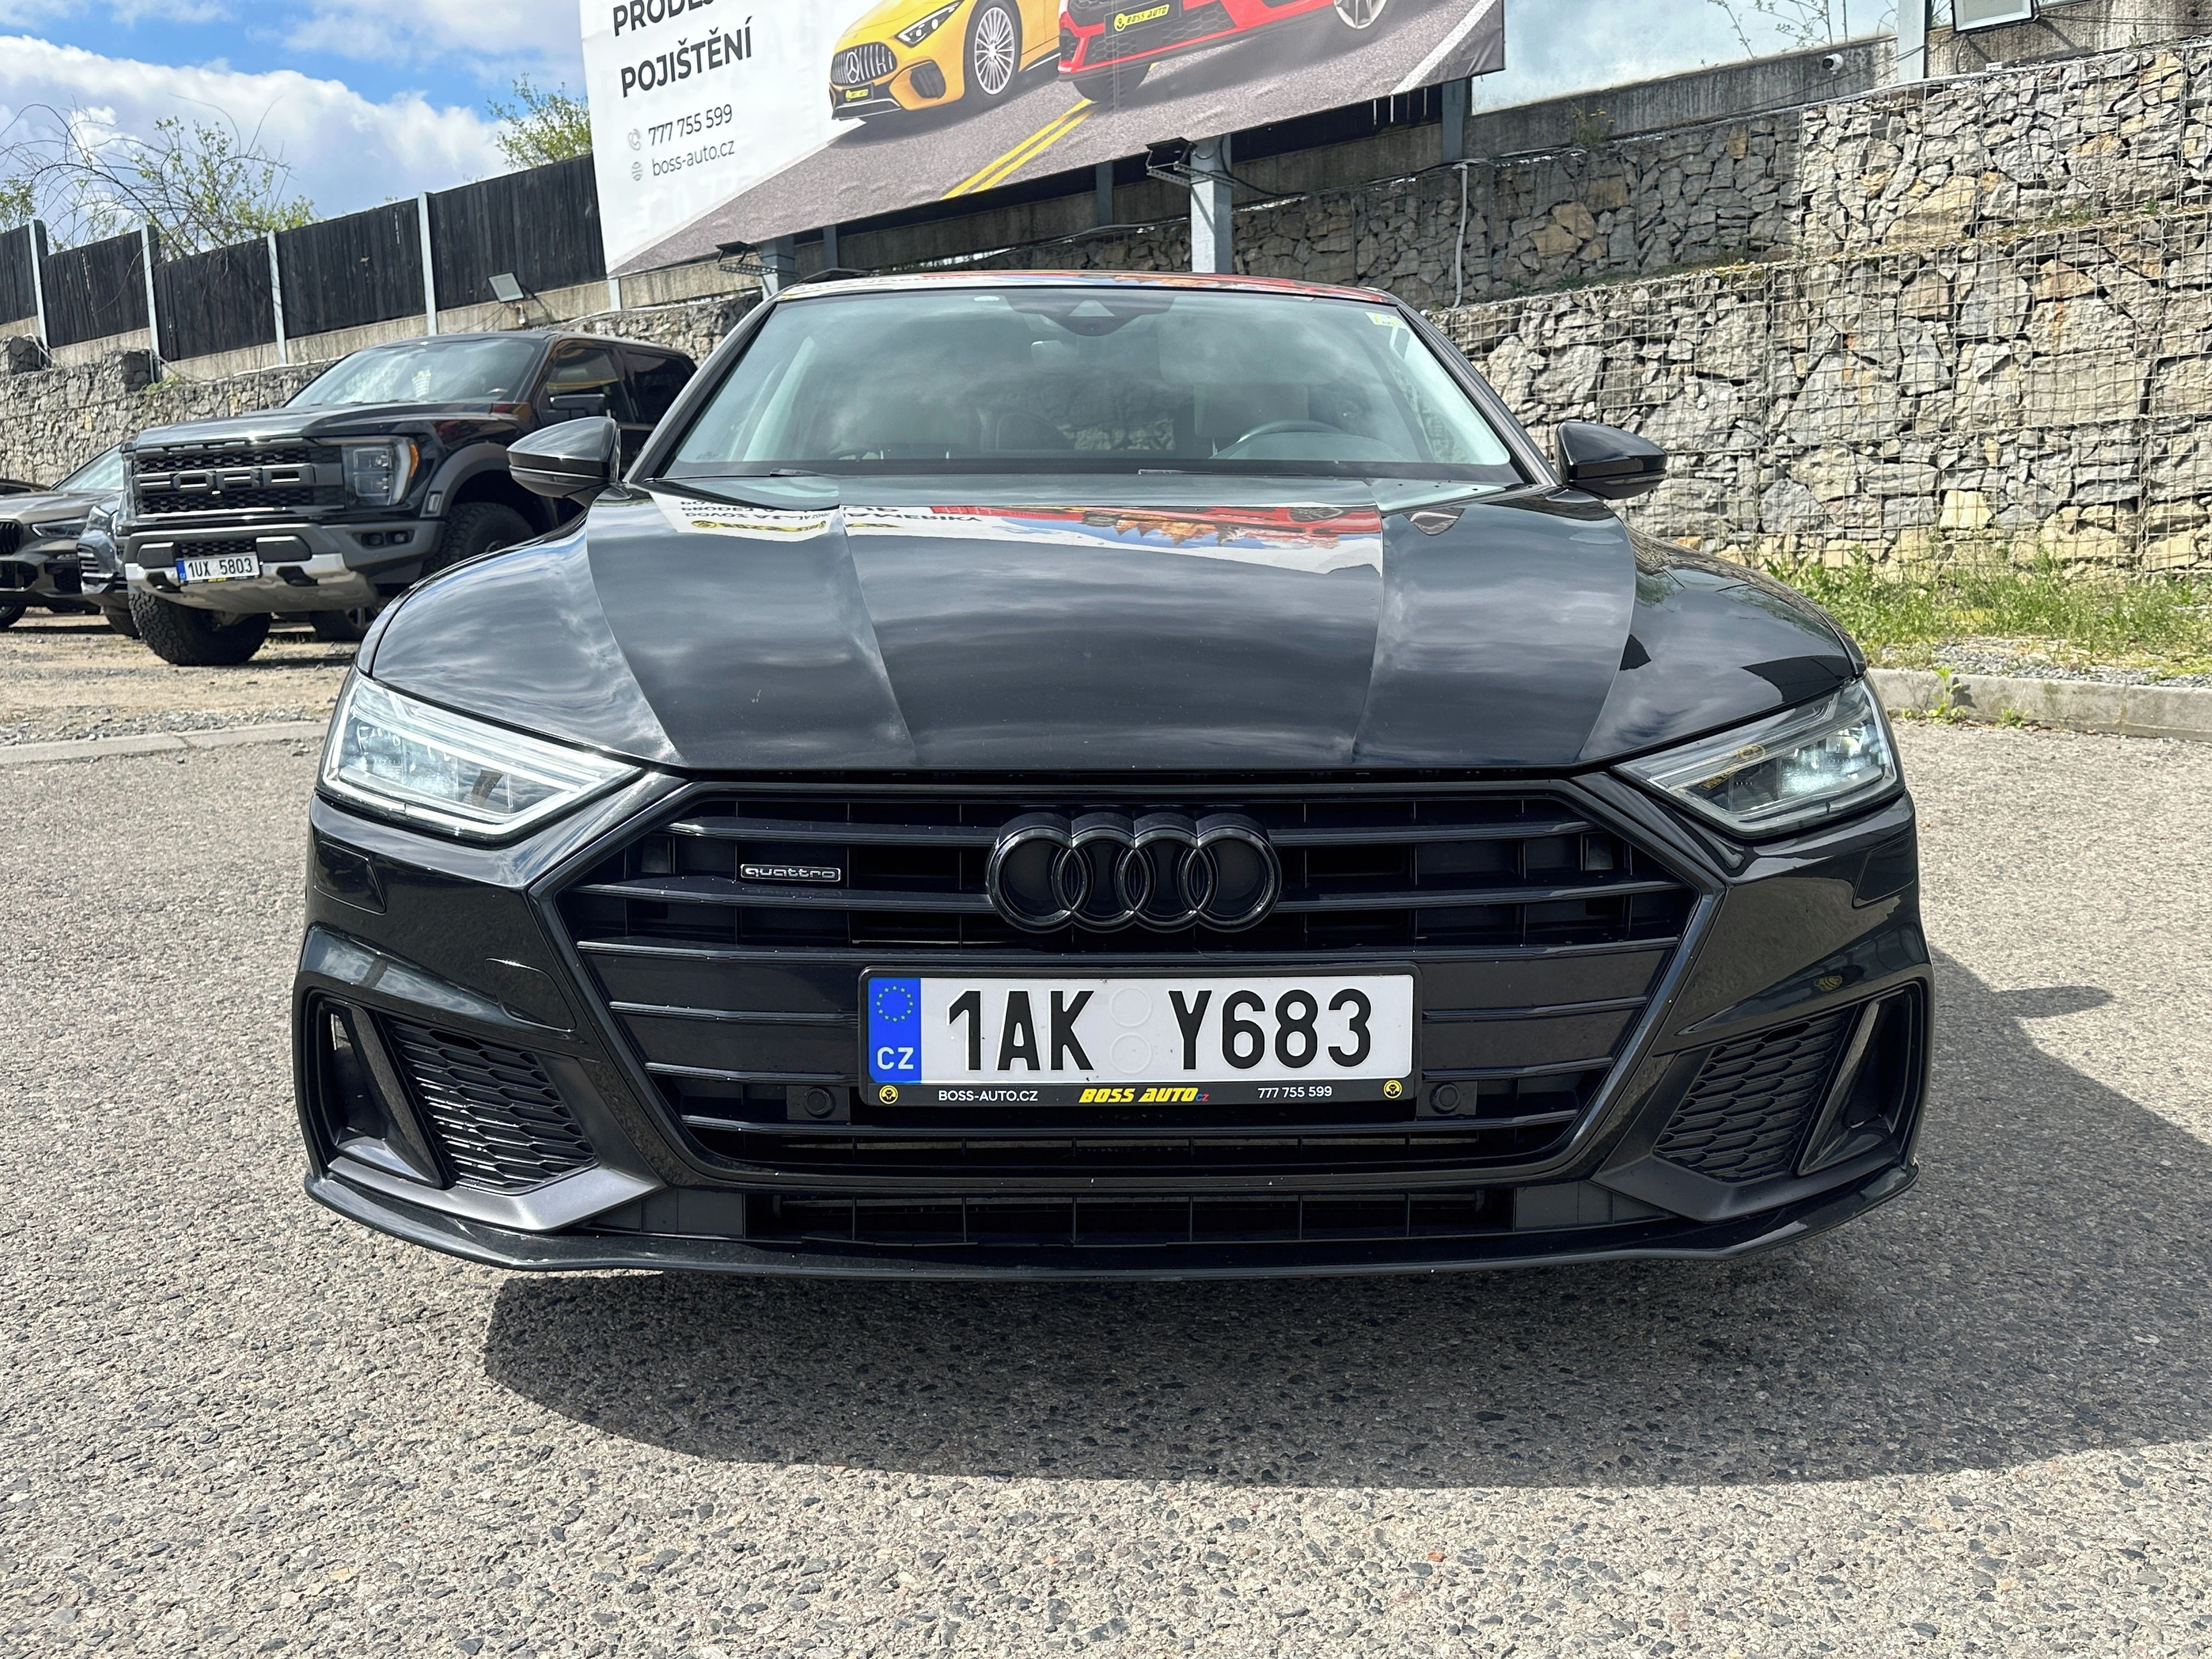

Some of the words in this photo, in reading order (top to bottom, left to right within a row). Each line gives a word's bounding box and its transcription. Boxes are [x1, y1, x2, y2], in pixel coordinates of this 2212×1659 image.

[613, 0, 714, 37] PROD
[620, 15, 753, 98] POJIŠTĚNÍ
[648, 122, 673, 146] 777
[677, 113, 702, 138] 755
[706, 104, 732, 129] 599
[652, 140, 735, 177] boss-auto.cz
[133, 463, 315, 495] FORD
[188, 561, 211, 578] 1UX
[219, 558, 252, 575] 5803
[745, 867, 836, 878] quattro
[877, 1046, 915, 1070] CZ
[949, 990, 1095, 1071] 1AK
[1168, 988, 1372, 1070] Y683
[939, 1090, 1039, 1101] BOSS-AUTO.CZ
[1079, 1088, 1136, 1103] BOSS
[1137, 1087, 1199, 1102] AUTO
[1257, 1087, 1279, 1098] 777
[1282, 1087, 1305, 1098] 755
[1308, 1086, 1332, 1097] 599
